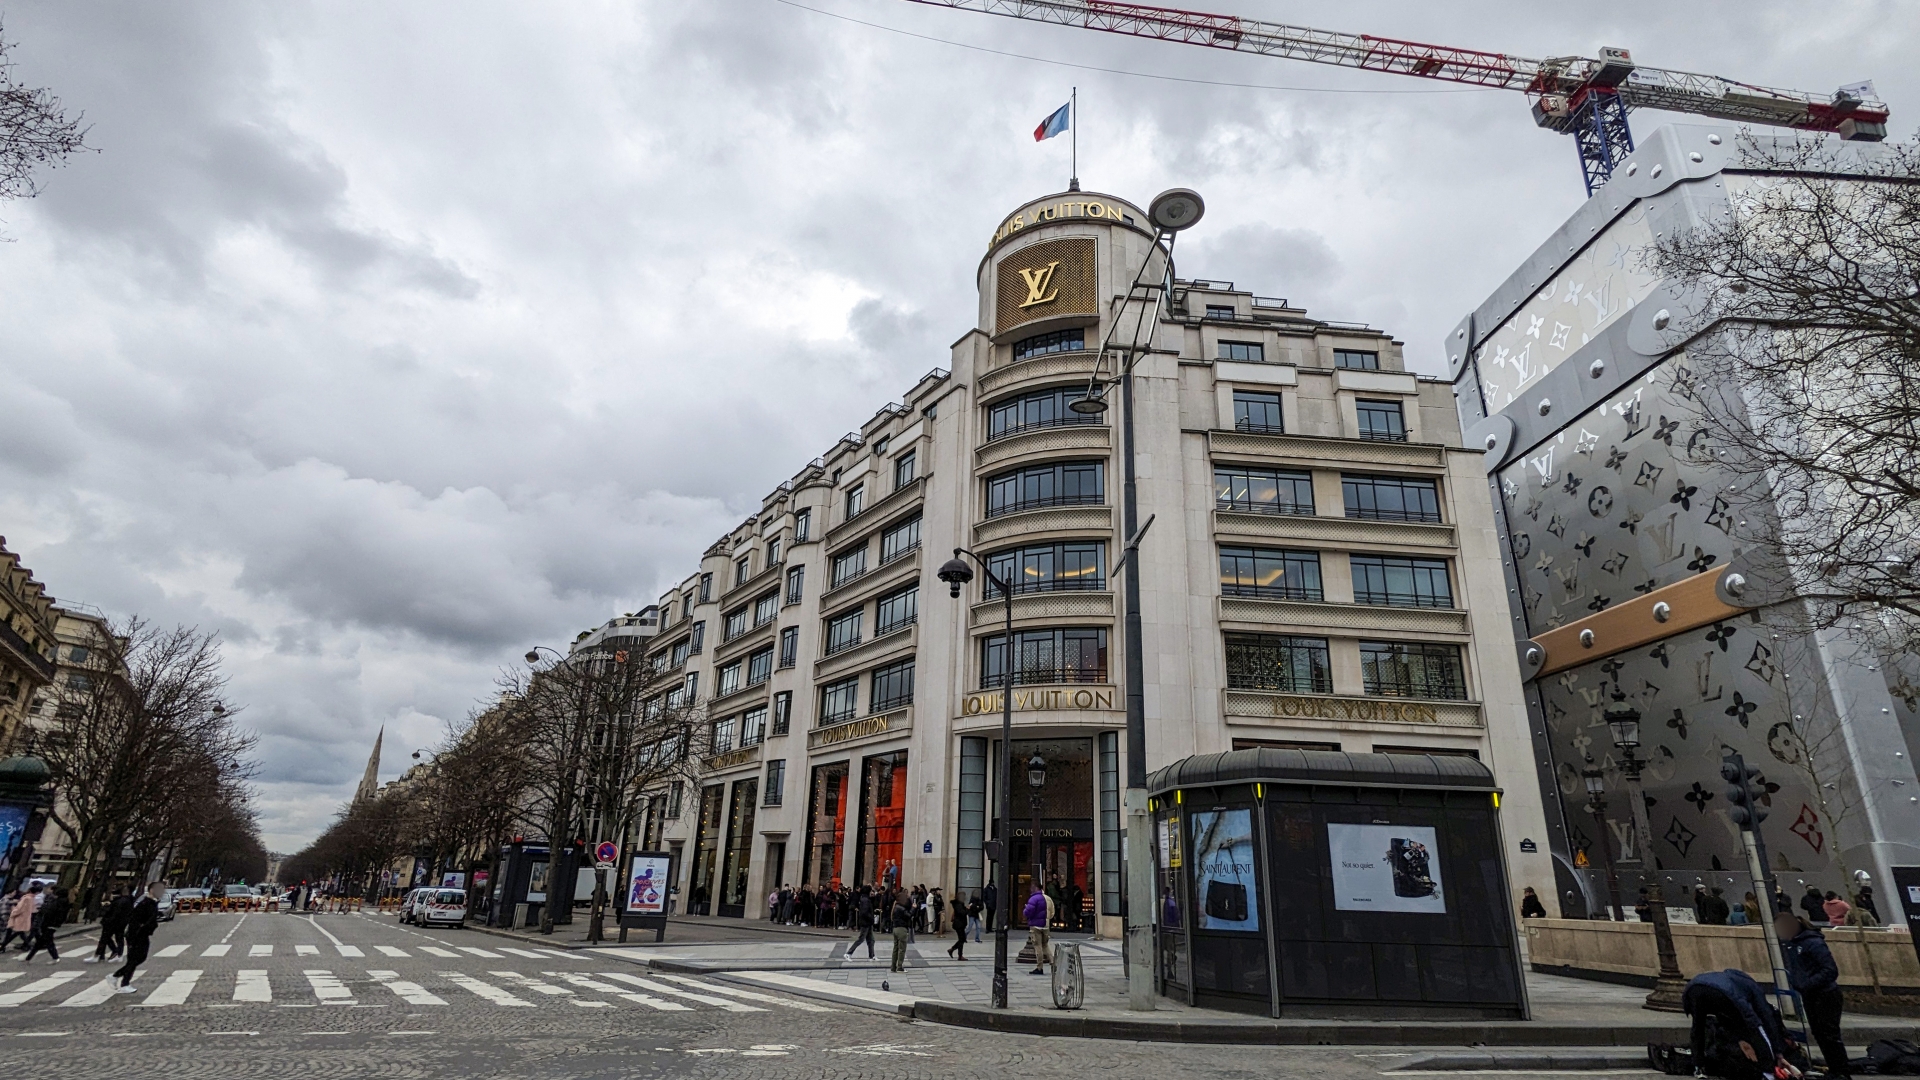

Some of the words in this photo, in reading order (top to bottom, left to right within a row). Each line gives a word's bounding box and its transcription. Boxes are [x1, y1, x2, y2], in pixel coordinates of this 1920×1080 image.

[1029, 202, 1123, 223] VUITTON
[962, 694, 1004, 716] LOUIS
[1014, 690, 1112, 710] VUITTON
[1273, 697, 1336, 718] LOUIS
[1341, 700, 1437, 723] VUITTON
[822, 726, 846, 745] LOUIS
[847, 715, 888, 739] VUITTON
[1012, 828, 1033, 837] LOUIS
[1040, 828, 1073, 837] UITTON
